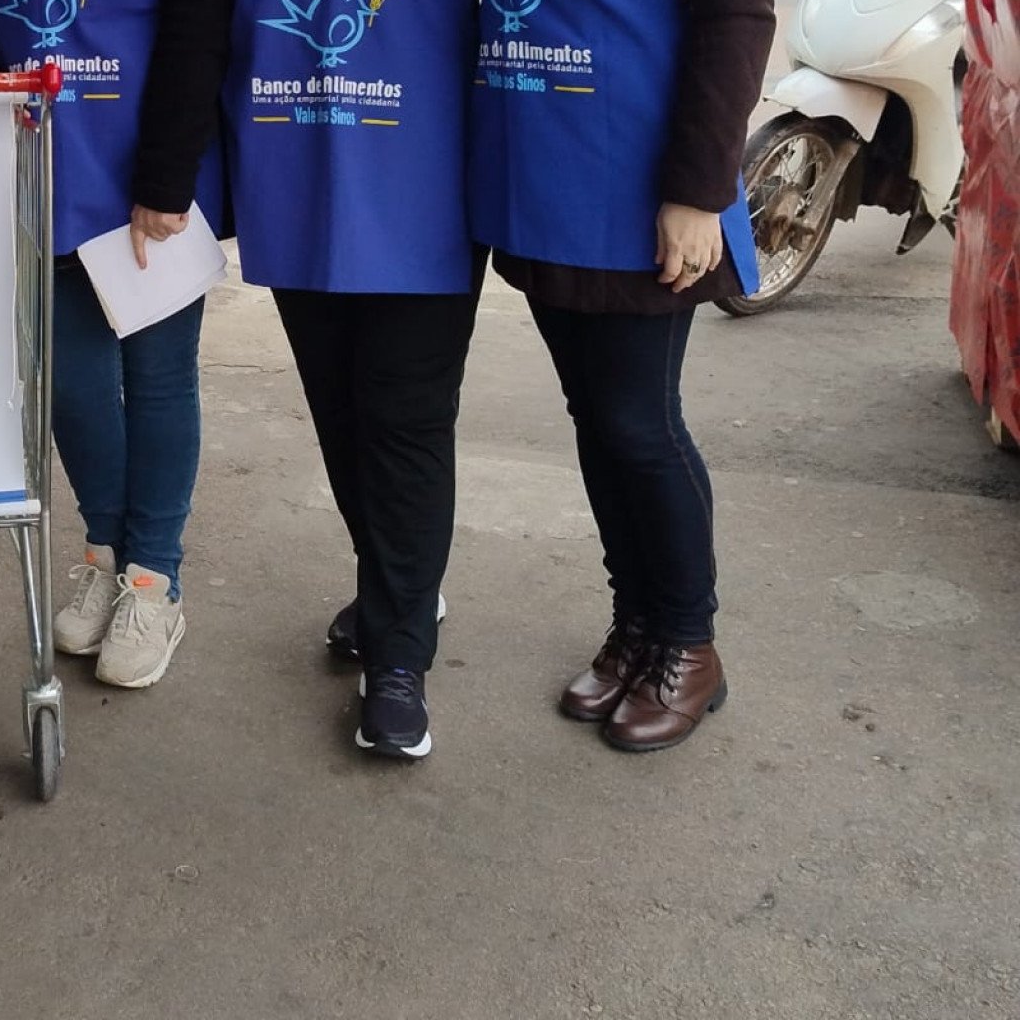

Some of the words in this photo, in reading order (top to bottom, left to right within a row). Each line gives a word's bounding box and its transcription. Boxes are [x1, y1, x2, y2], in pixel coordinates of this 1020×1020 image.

[507, 40, 592, 64] Alimentos
[547, 63, 593, 74] cidadania
[252, 77, 301, 95] Banco
[323, 75, 402, 98] Alimentos
[516, 72, 546, 93] Sinos
[358, 98, 400, 107] cidadania
[295, 106, 316, 125] Vale
[330, 106, 356, 125] Sinos
